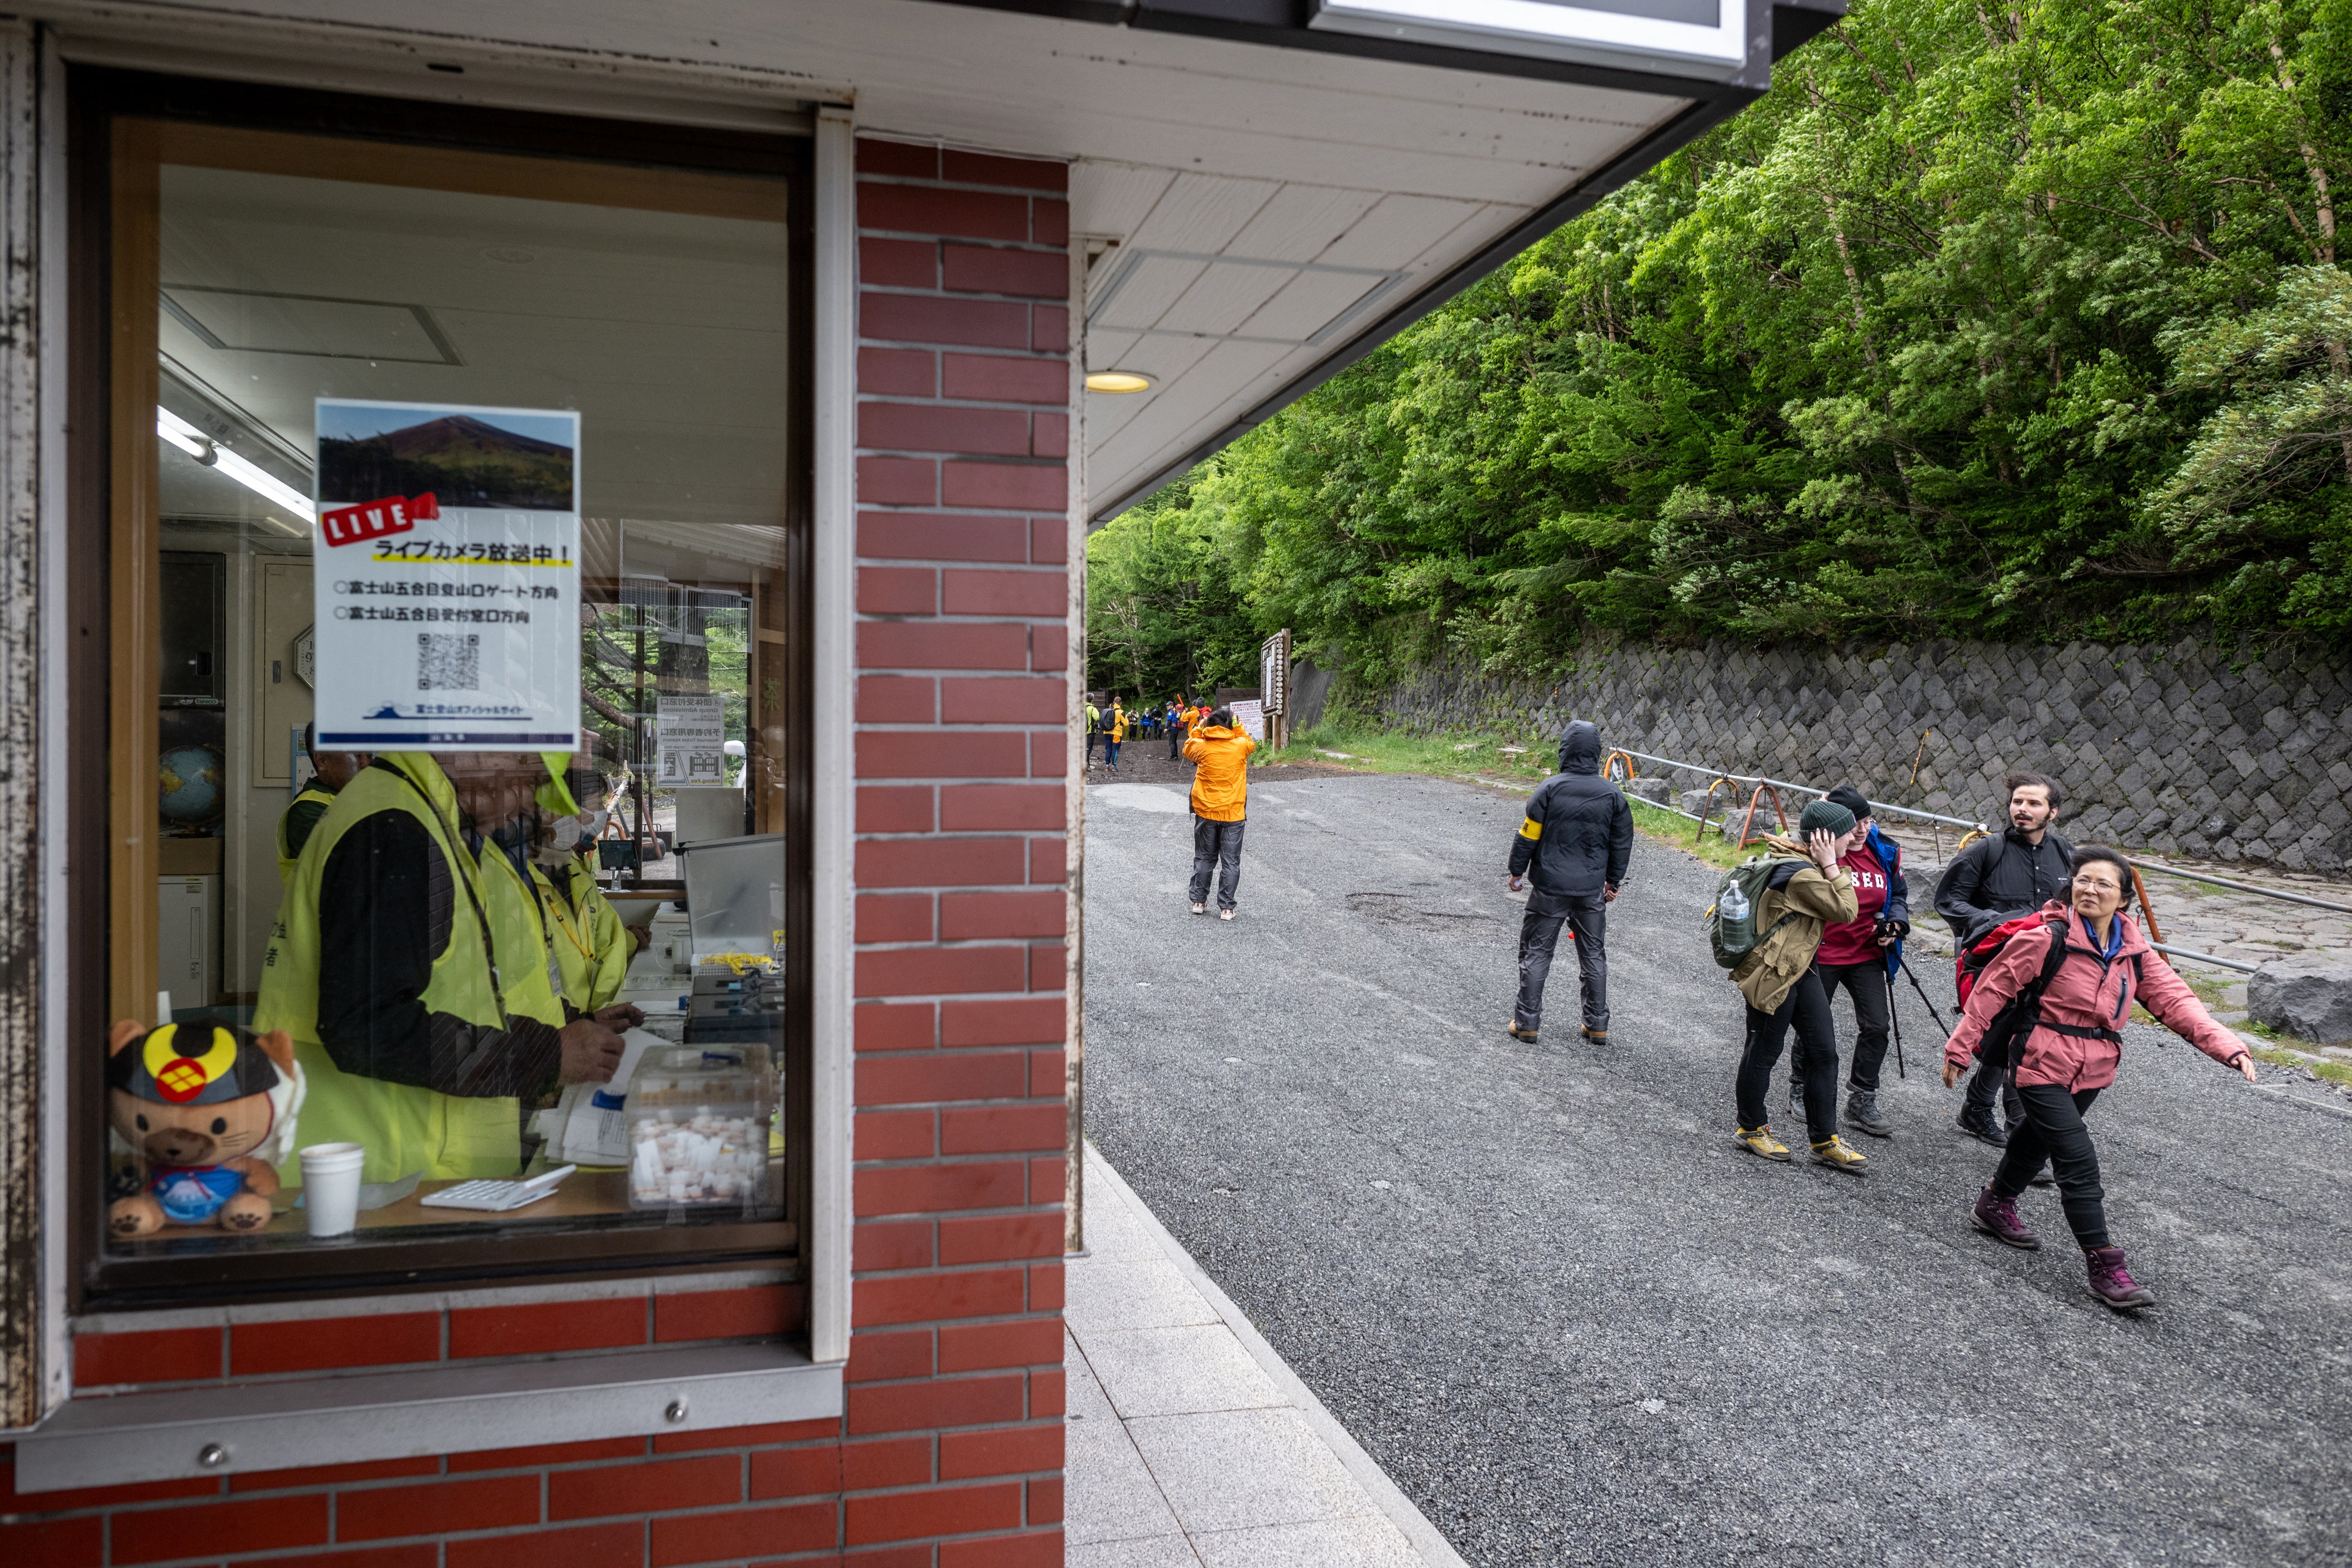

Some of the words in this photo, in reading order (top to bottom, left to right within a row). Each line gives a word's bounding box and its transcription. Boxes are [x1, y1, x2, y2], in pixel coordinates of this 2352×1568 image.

[328, 503, 407, 539] LIVE
[375, 540, 568, 564] ライブカメラ放送中！
[306, 654, 312, 663] 9
